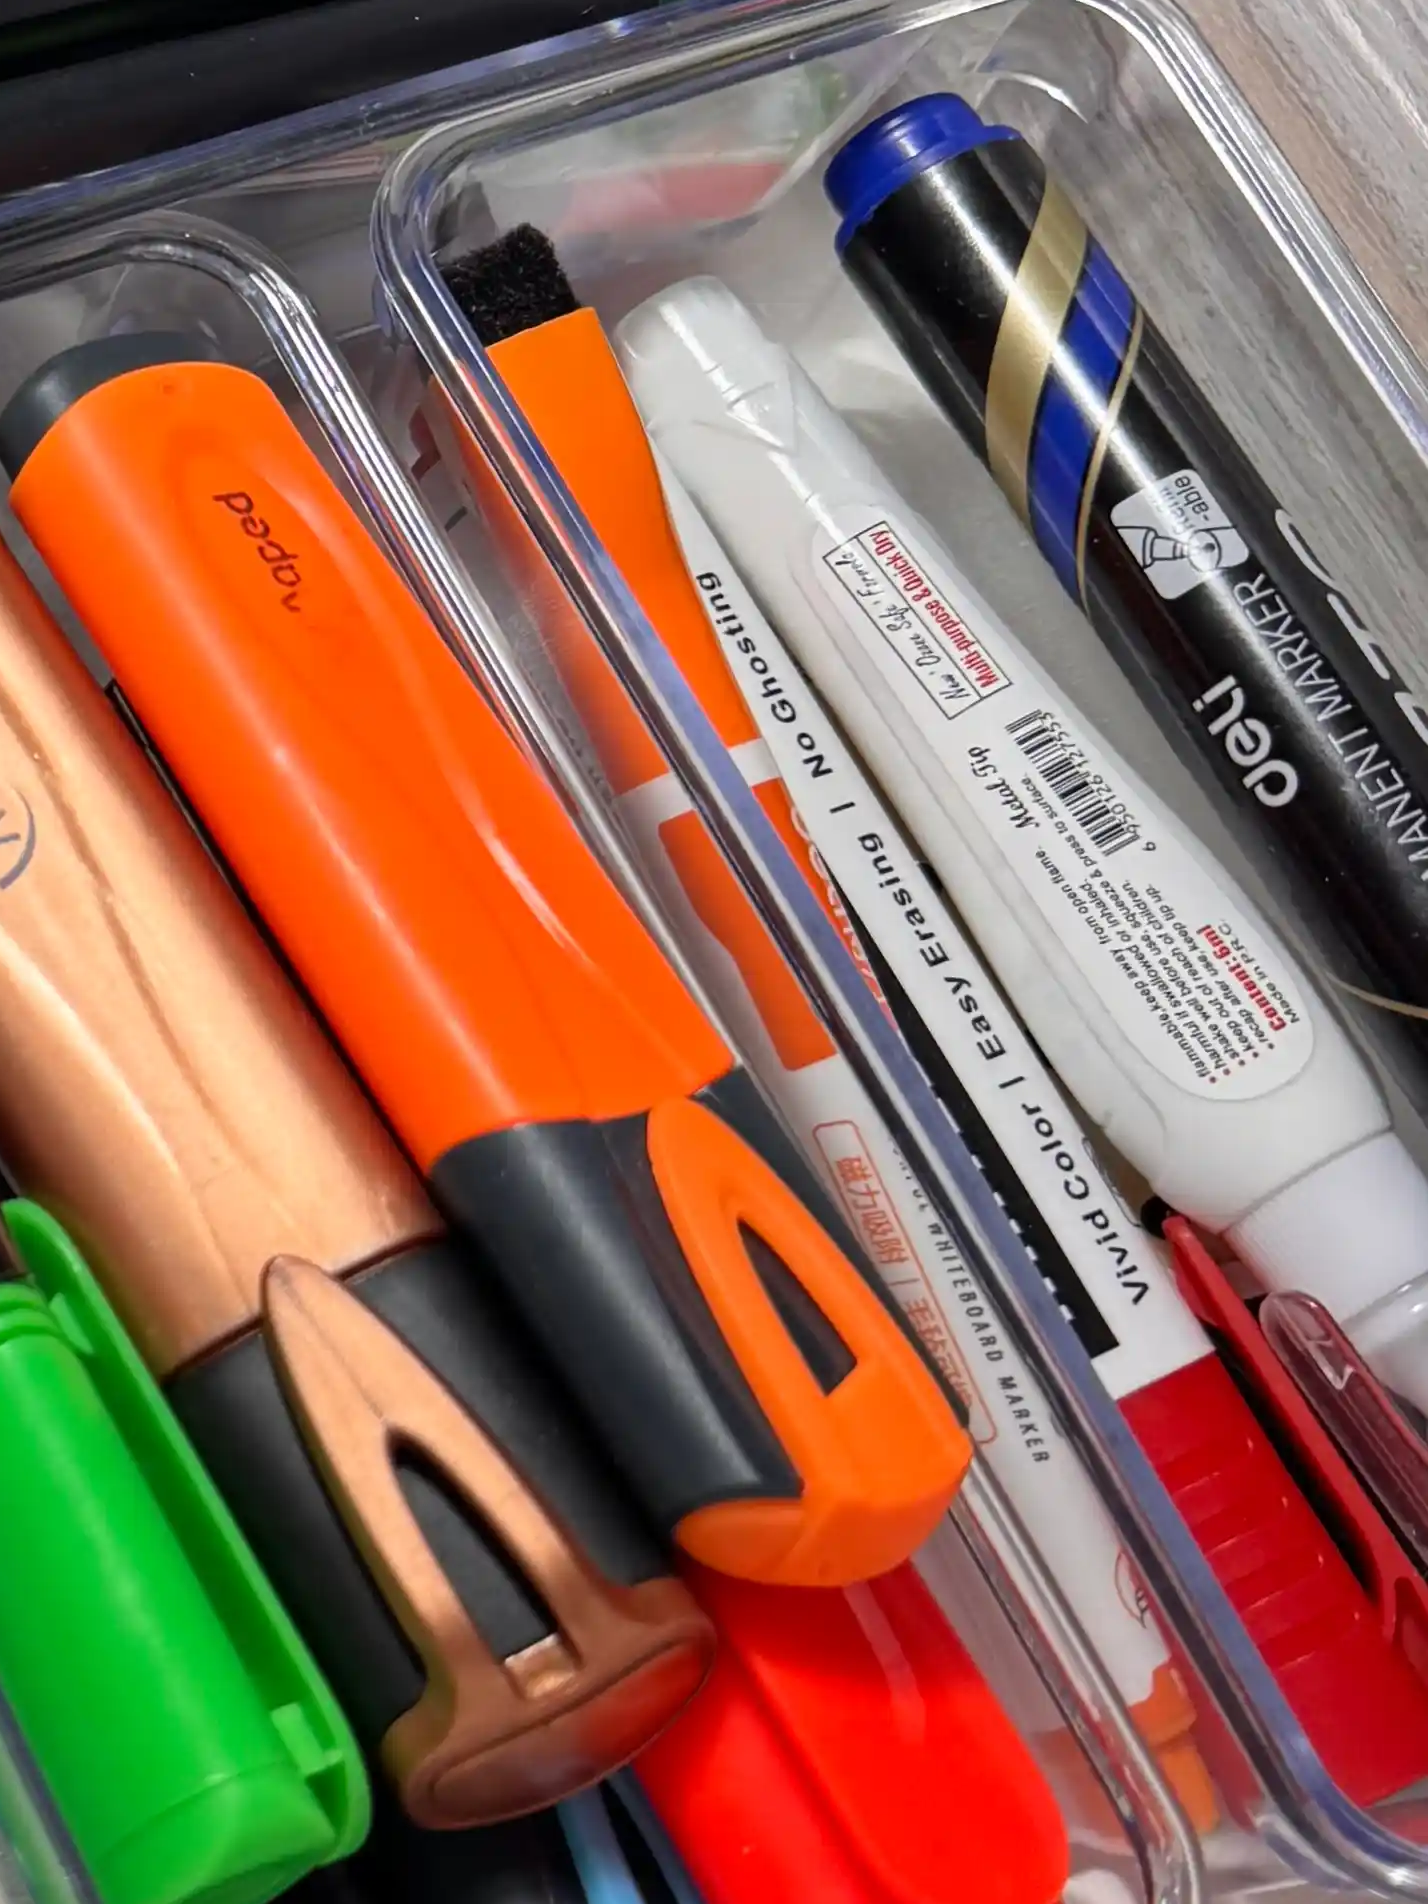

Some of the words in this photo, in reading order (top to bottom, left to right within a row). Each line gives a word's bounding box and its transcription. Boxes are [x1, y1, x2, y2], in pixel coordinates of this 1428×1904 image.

[867, 534, 895, 556] Dry
[886, 551, 922, 593] Quick
[694, 571, 799, 727] Ghosting
[921, 598, 1000, 689] Multi-purpose
[1234, 573, 1351, 722] MARKER
[792, 729, 833, 781] No
[1038, 709, 1090, 768] 127553
[1192, 675, 1298, 807] deli
[986, 775, 1041, 832] Metal
[1090, 771, 1142, 834] 950126
[1328, 733, 1428, 882] MANENT
[1063, 833, 1096, 868] press
[855, 832, 950, 970] Erasing
[1060, 882, 1091, 916] open
[1097, 878, 1142, 930] squeeze
[1083, 913, 1112, 946] from
[1107, 946, 1139, 980] away
[1126, 943, 1182, 1009] swallowed
[1155, 955, 1192, 997] before
[1169, 945, 1202, 982] reach
[1186, 995, 1210, 1022] well
[1212, 978, 1242, 1008] after
[1264, 980, 1300, 1024] Made
[940, 977, 1007, 1062] Easy
[1180, 1018, 1227, 1070] harmful
[1204, 1021, 1240, 1061] shake
[1224, 1020, 1254, 1052] keep
[1237, 1008, 1268, 1044] recap
[1020, 1105, 1091, 1198] Color
[1081, 1206, 1148, 1305] Vivid
[927, 1221, 1006, 1364] WHITEBOARD
[996, 1373, 1051, 1465] MARKER
